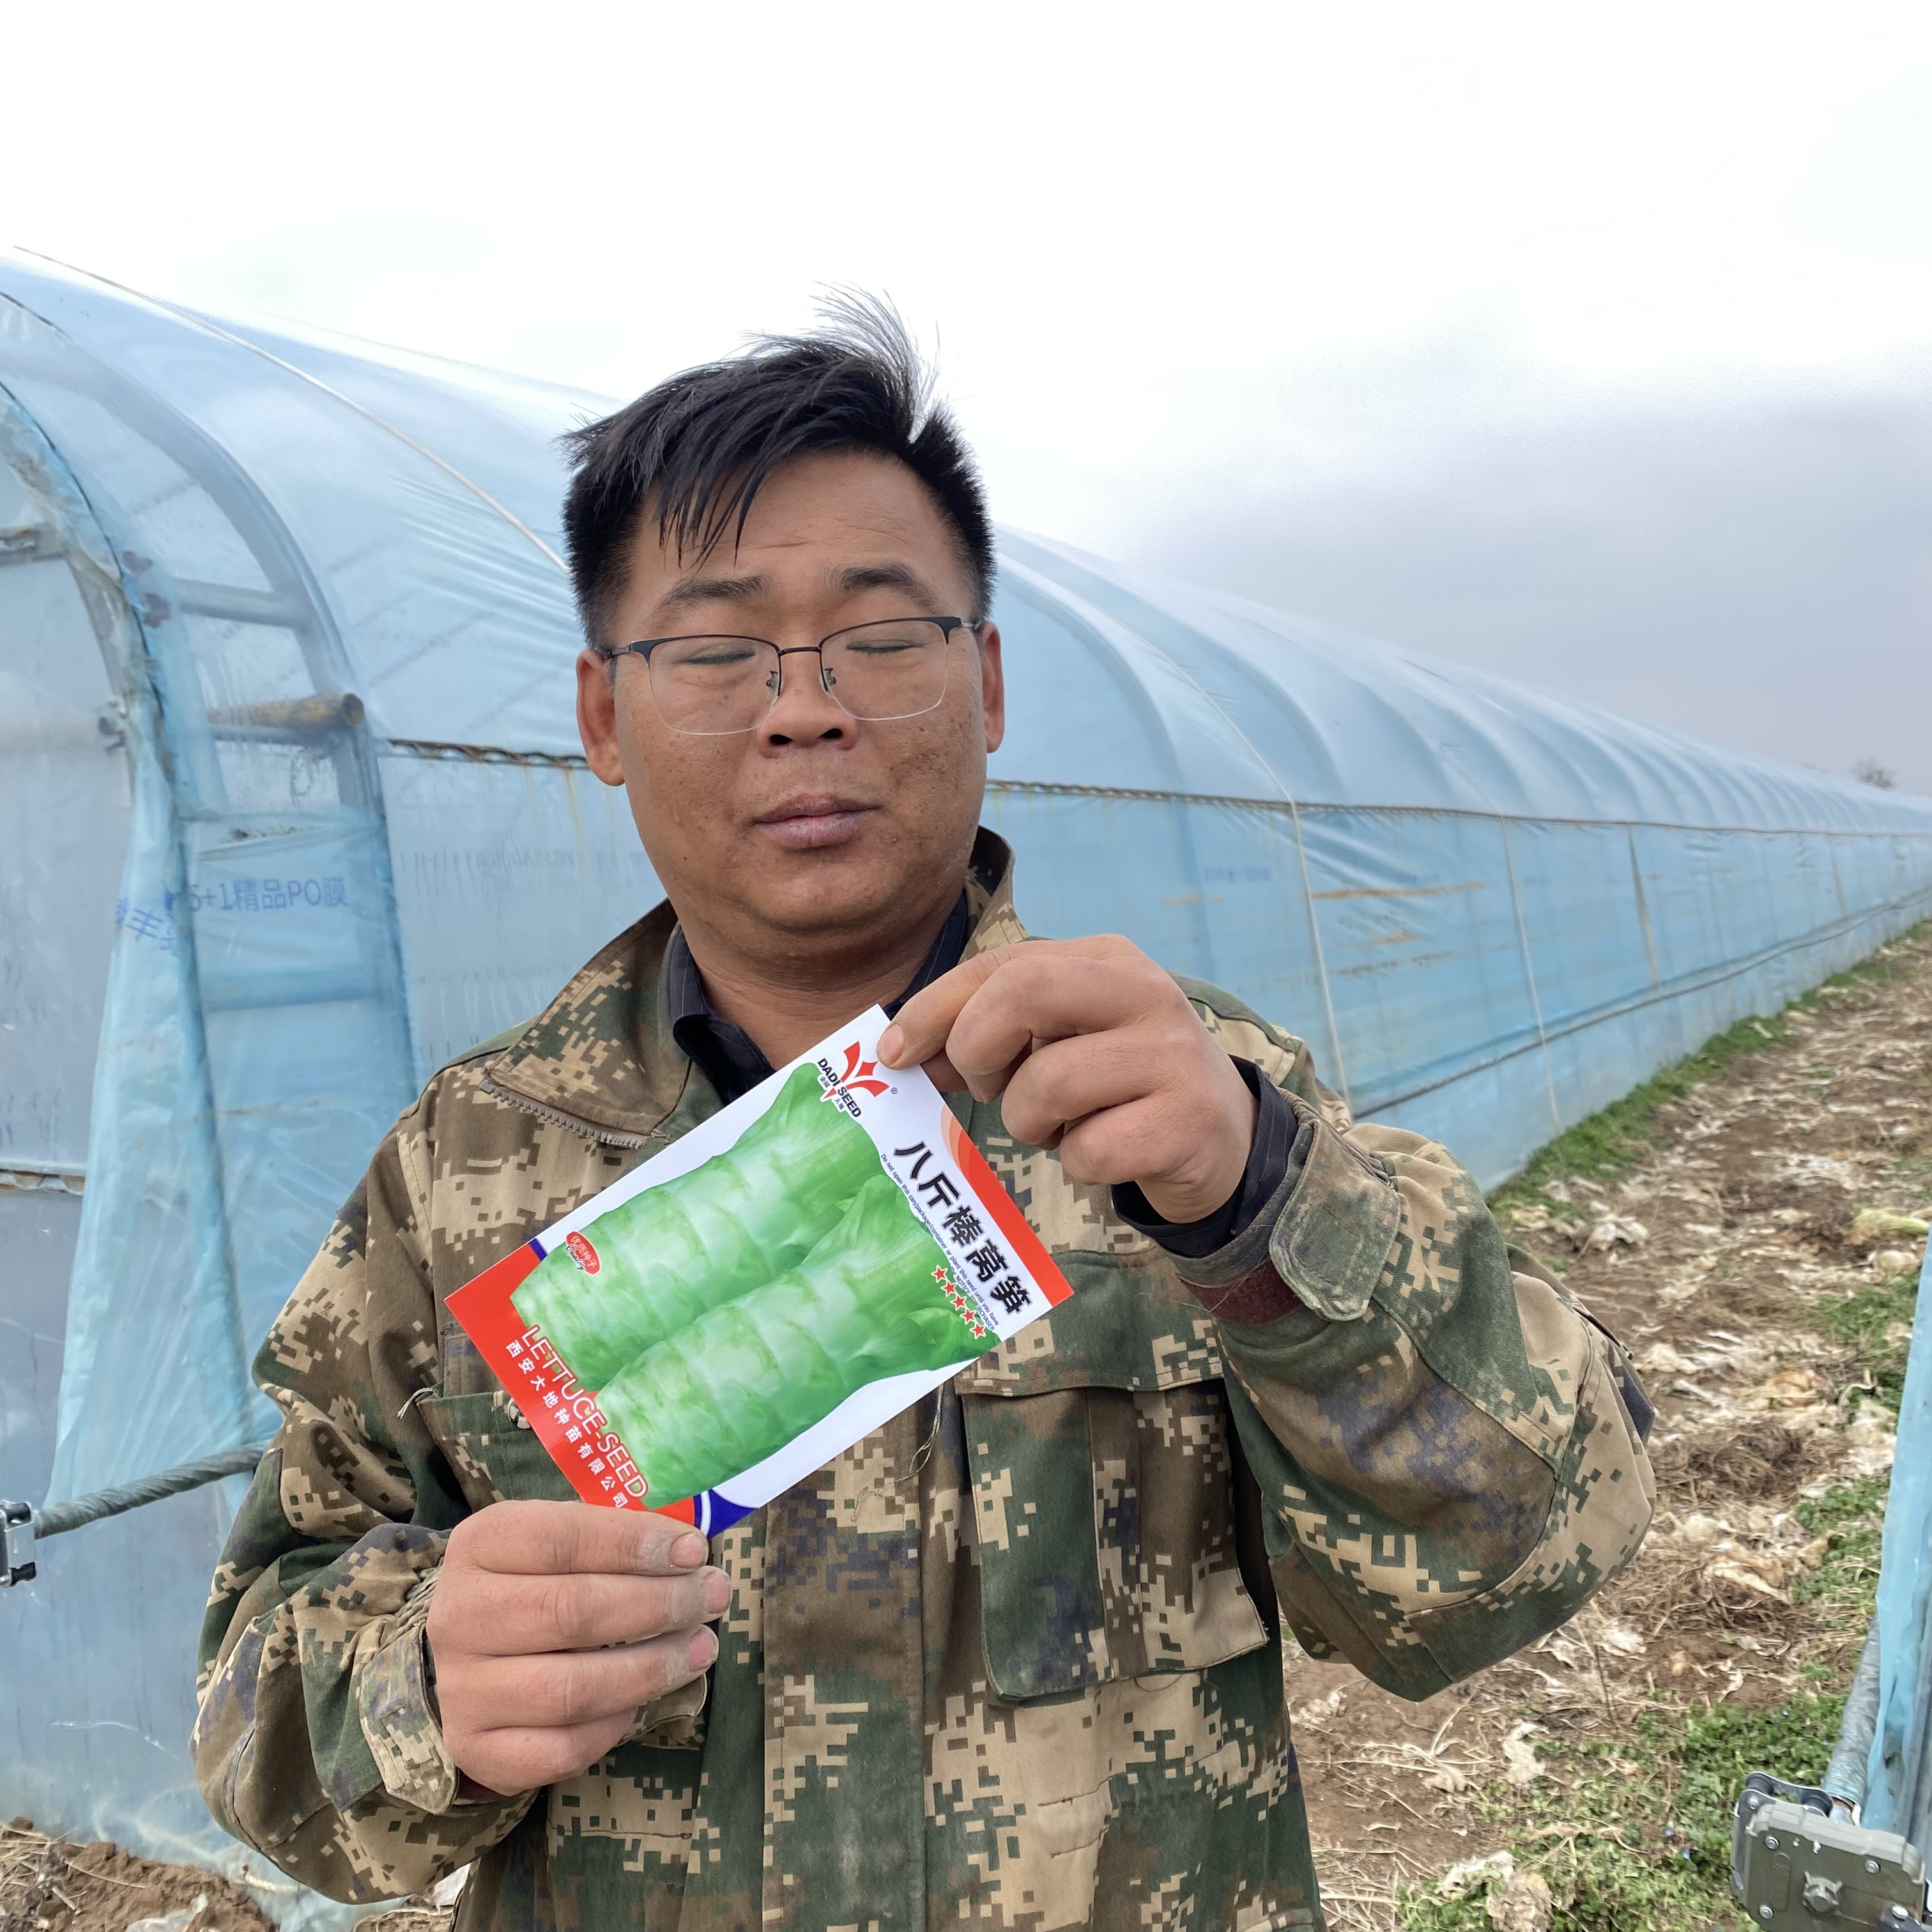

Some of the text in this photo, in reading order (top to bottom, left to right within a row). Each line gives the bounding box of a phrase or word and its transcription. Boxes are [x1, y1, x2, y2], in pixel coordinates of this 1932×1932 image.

[817, 1058, 861, 1117] DADI SEED
[571, 1236, 597, 1268] 优质种子
[881, 1154, 888, 1163] Do
[886, 1162, 894, 1172] not
[891, 1171, 903, 1186] open
[901, 1184, 910, 1195] this
[907, 1195, 948, 1249] can/package/container
[949, 1255, 962, 1270] plant
[960, 1269, 968, 1280] this
[966, 1279, 976, 1292] seed
[974, 1291, 984, 1303] until
[981, 1303, 990, 1314] you
[989, 1312, 999, 1326] have
[894, 1142, 1031, 1314] 八斤棒莴笋
[955, 1276, 970, 1295] NOTICE
[505, 1340, 628, 1508] 西安大地种苗有限公司
[521, 1326, 649, 1499] LETTUCE-SEED
